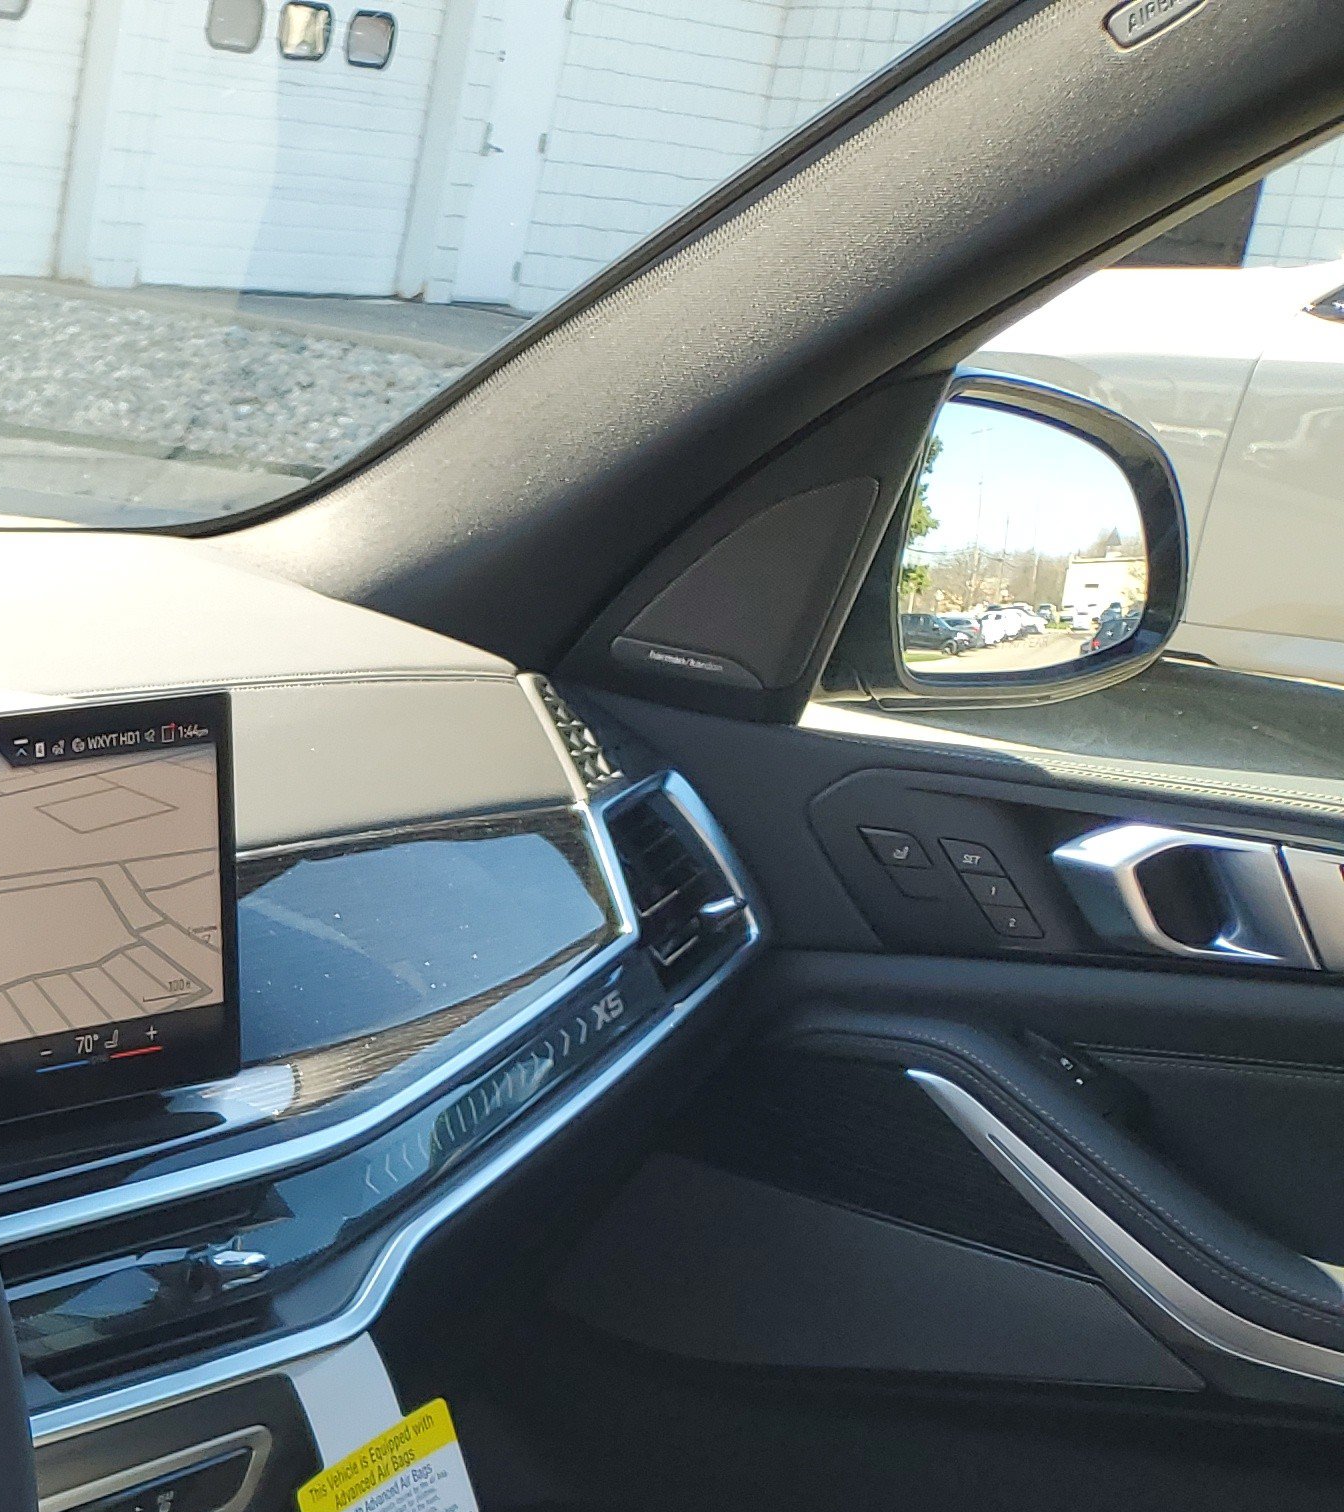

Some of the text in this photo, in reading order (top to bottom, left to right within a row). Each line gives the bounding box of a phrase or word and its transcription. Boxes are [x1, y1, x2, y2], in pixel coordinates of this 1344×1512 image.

[1128, 0, 1177, 33] AIRB
[87, 730, 141, 750] WXYT HD1
[962, 853, 981, 865] SET
[591, 989, 624, 1031] X5
[308, 1481, 328, 1502] This
[326, 1461, 360, 1490] Vehicle
[368, 1424, 412, 1463] Equipped
[412, 1414, 434, 1437] with
[412, 1464, 432, 1482] Bags
[335, 1448, 415, 1510] Advanced Air Bags
